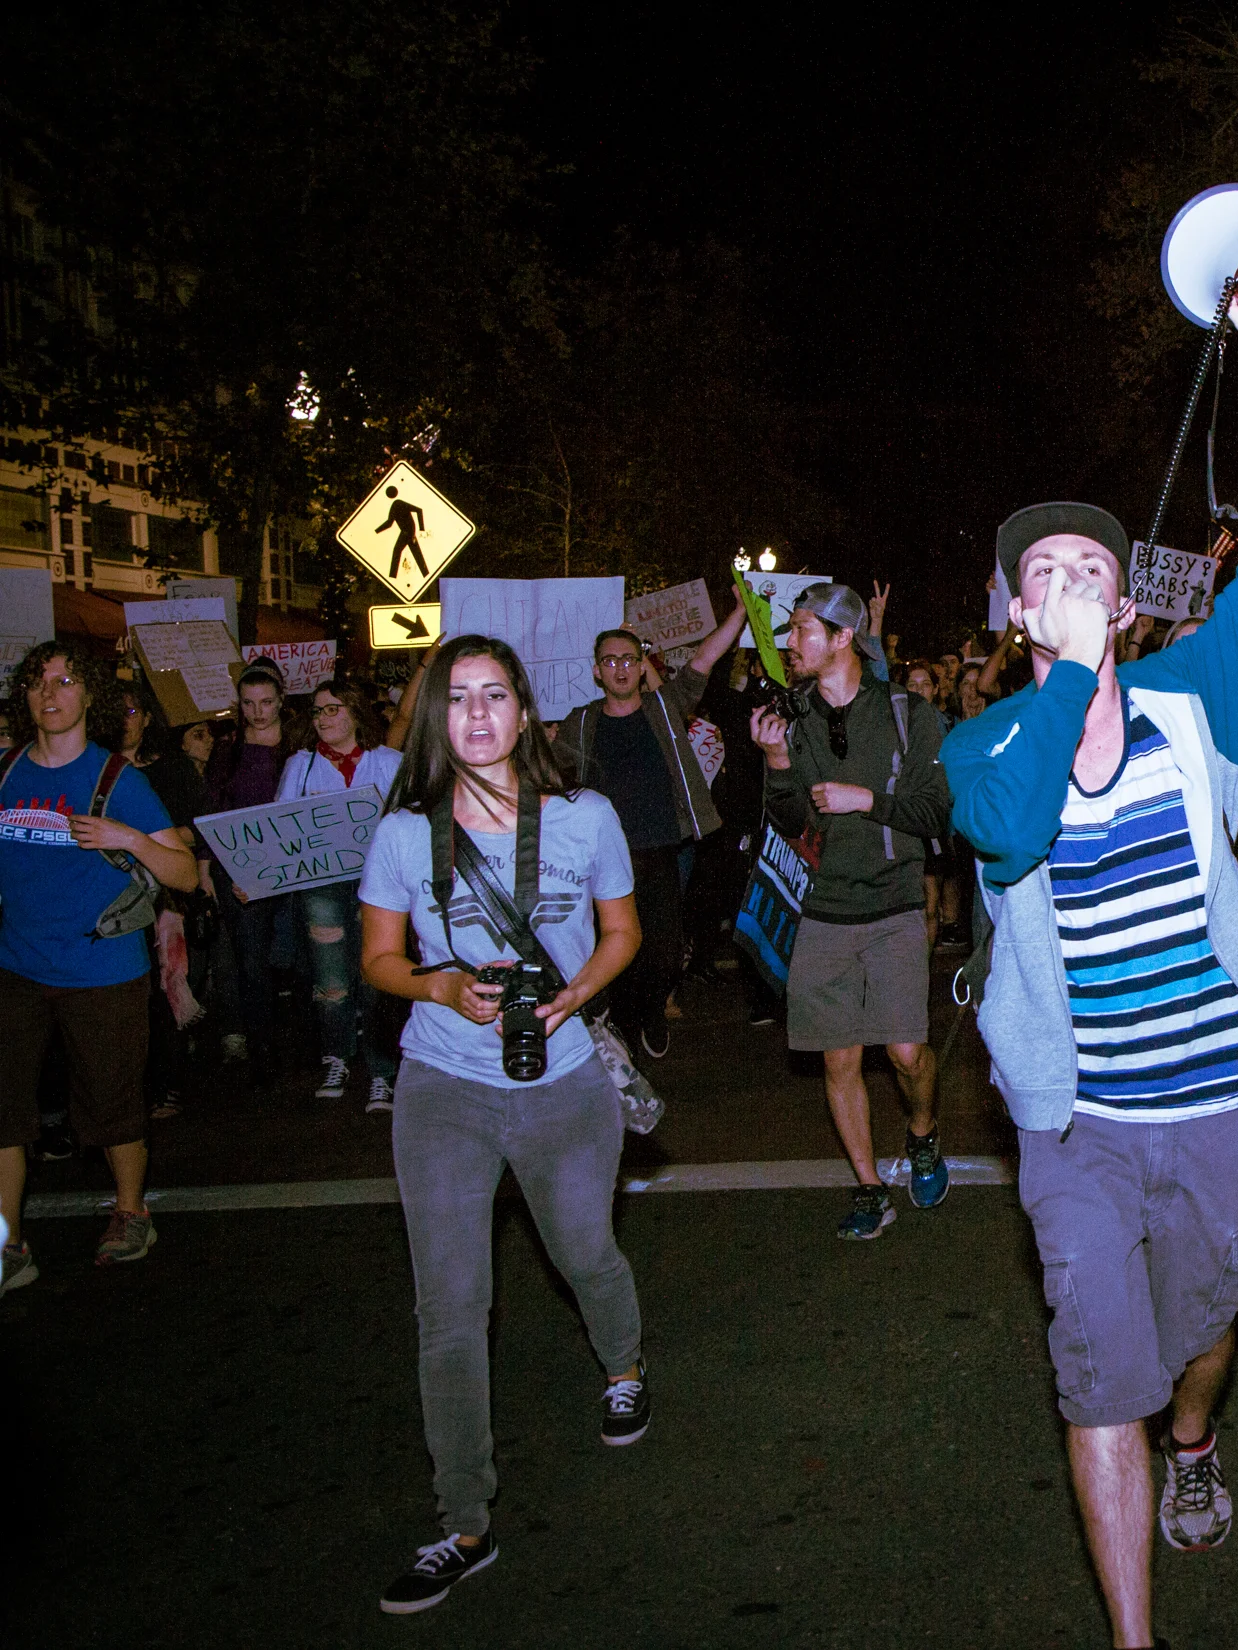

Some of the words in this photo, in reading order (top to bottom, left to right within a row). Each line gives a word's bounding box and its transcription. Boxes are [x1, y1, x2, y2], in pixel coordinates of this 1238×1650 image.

[1132, 570, 1188, 595] GRABS
[1135, 587, 1176, 610] BACK
[247, 643, 330, 663] AMERICA
[213, 800, 379, 851] UNITED
[279, 833, 333, 857] WE
[257, 849, 366, 890] STAND
